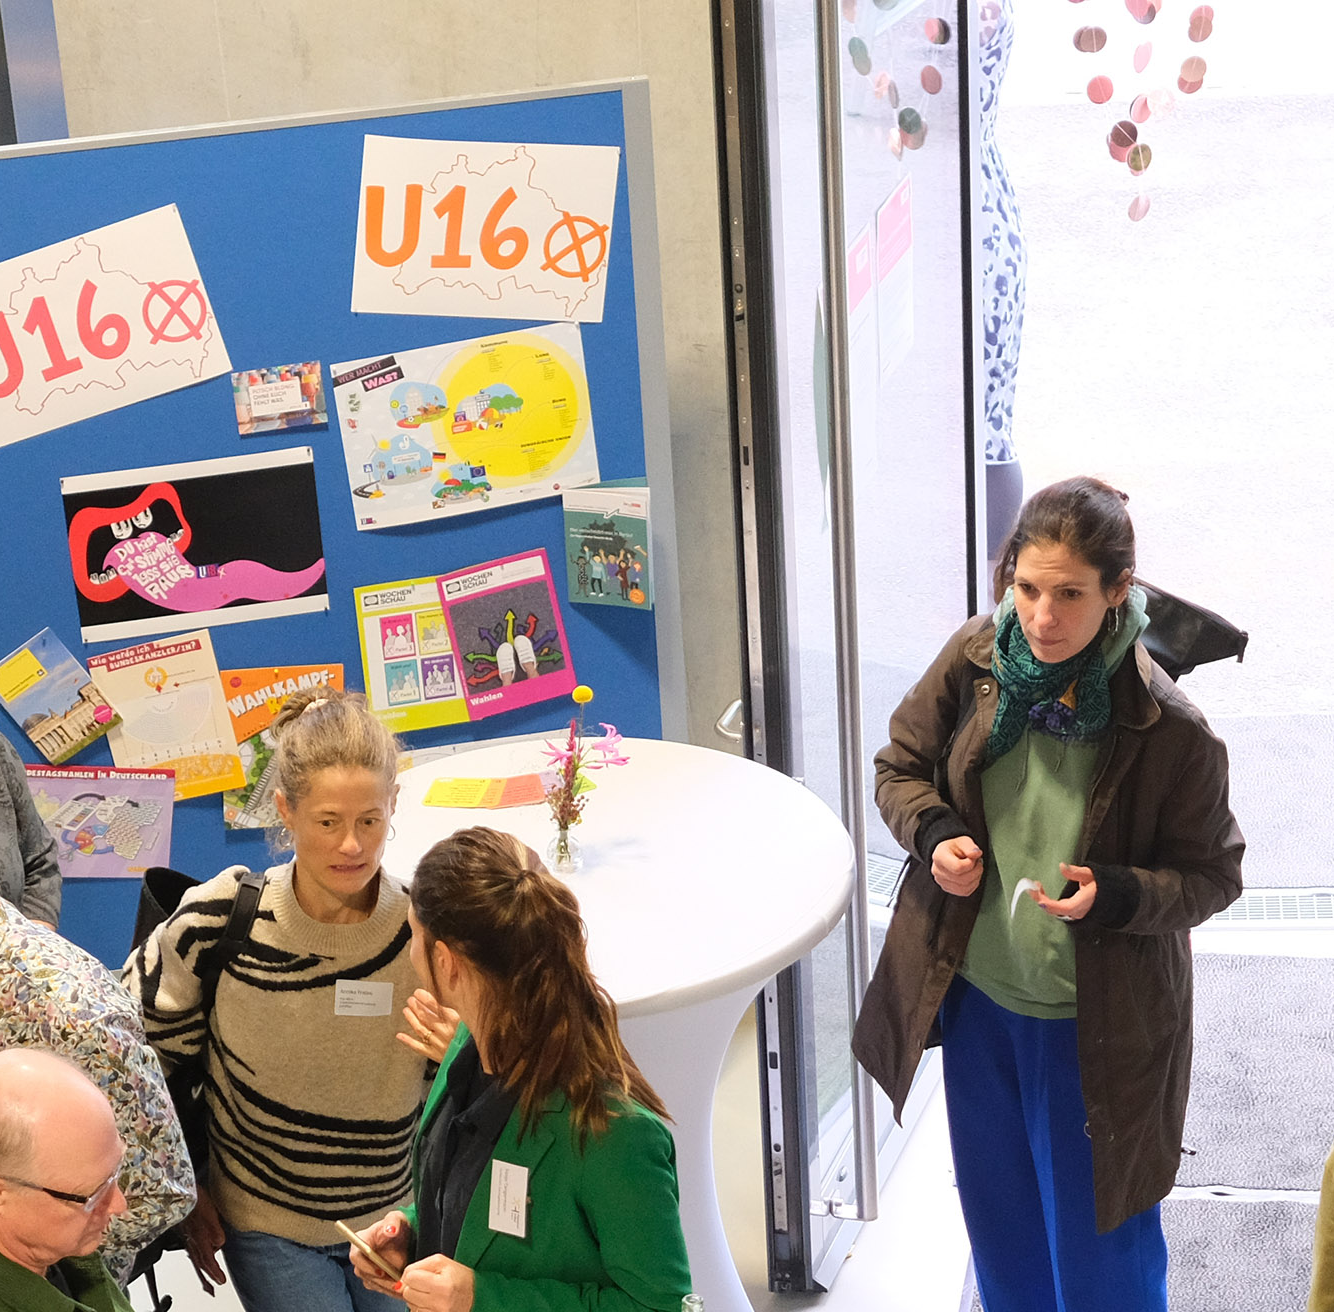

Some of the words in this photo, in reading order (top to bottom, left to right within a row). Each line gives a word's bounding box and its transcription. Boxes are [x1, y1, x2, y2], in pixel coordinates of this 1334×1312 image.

[365, 184, 529, 270] U16
[337, 372, 355, 384] WER
[356, 361, 382, 376] MACHT
[364, 371, 398, 390] WAS?
[461, 571, 493, 585] WOCHEN
[462, 578, 488, 591] SCHAU
[379, 589, 412, 599] WOCHEN
[380, 596, 406, 605] SCHAU
[90, 658, 107, 666] Wie
[137, 645, 151, 654] ich
[109, 641, 196, 670] BUNDESKANZLER/IN?
[228, 670, 335, 718] WAHLKAMPF-
[470, 691, 503, 707] Wahlen
[25, 769, 94, 779] DESTAGSWAHLEN
